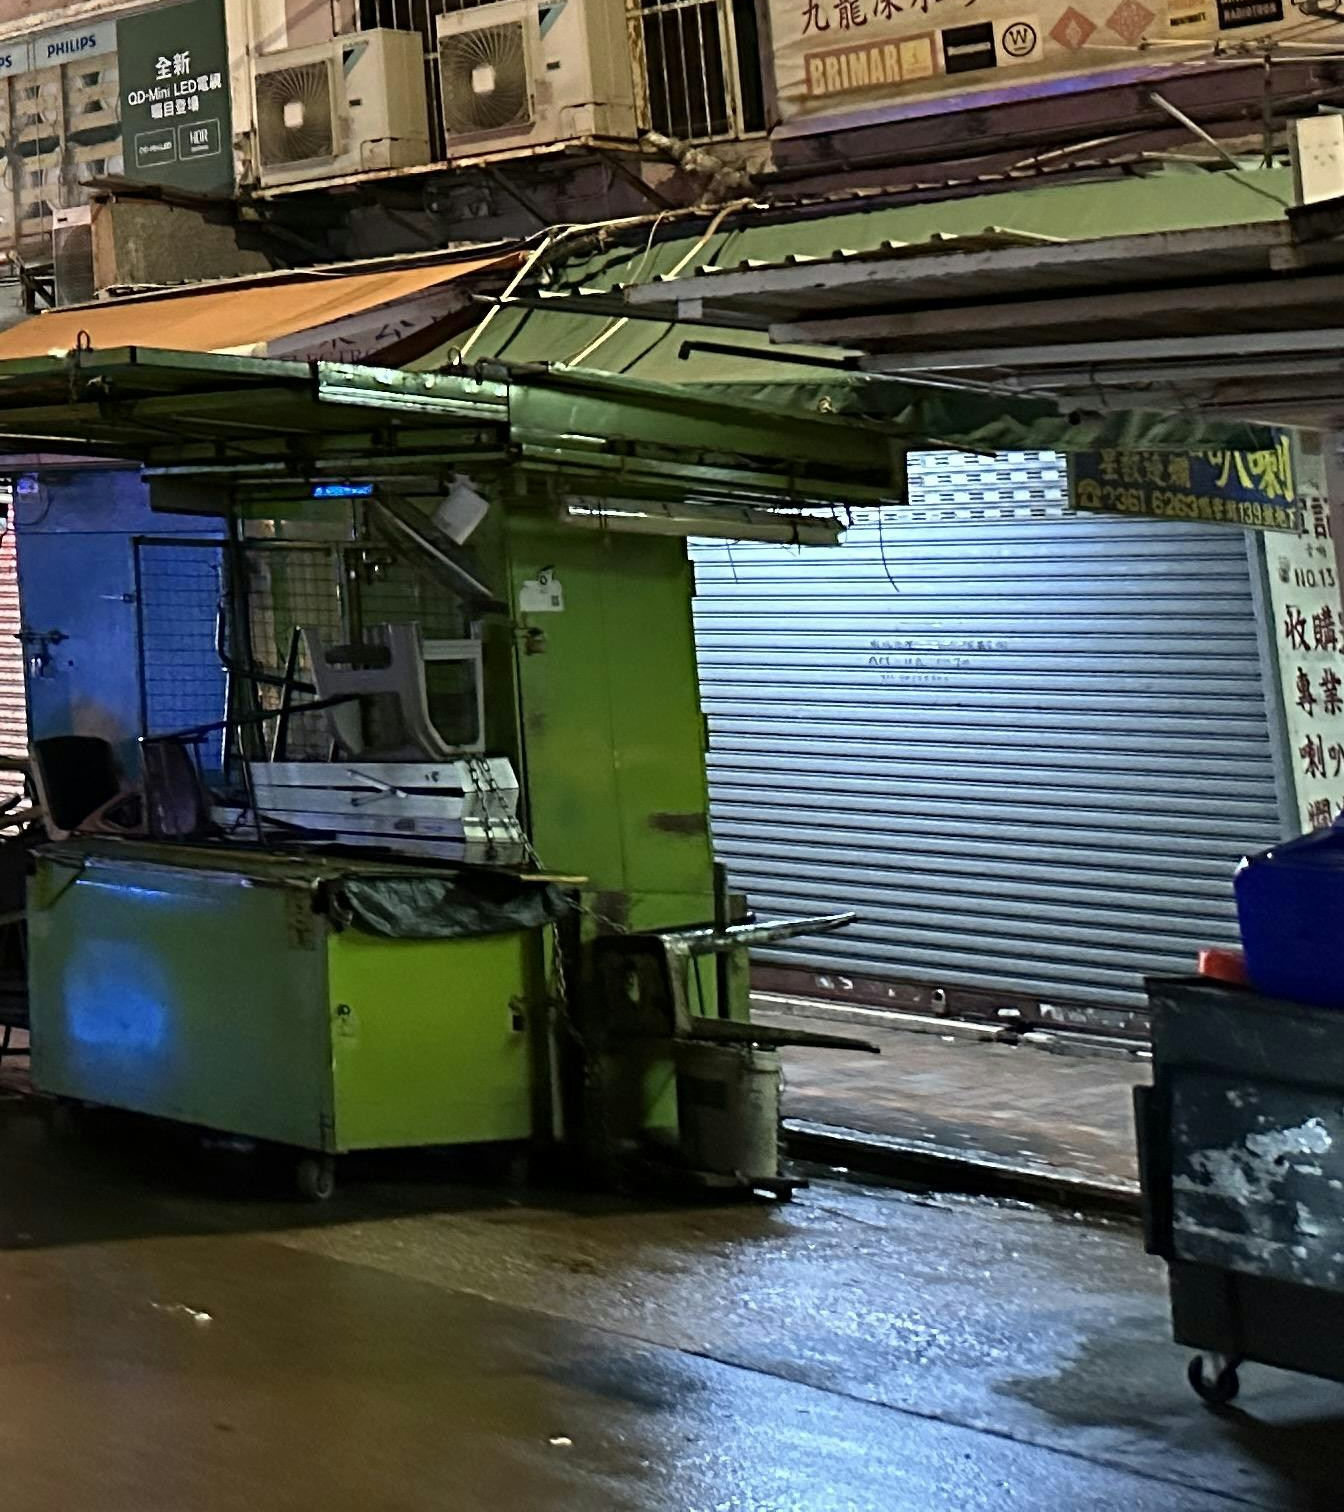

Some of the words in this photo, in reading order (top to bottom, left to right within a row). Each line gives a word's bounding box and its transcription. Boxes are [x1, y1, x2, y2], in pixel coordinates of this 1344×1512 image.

[47, 34, 97, 59] PHILIPS
[154, 51, 190, 80] 全新
[810, 44, 901, 95] BRIMAR
[128, 86, 171, 106] QD-Mini
